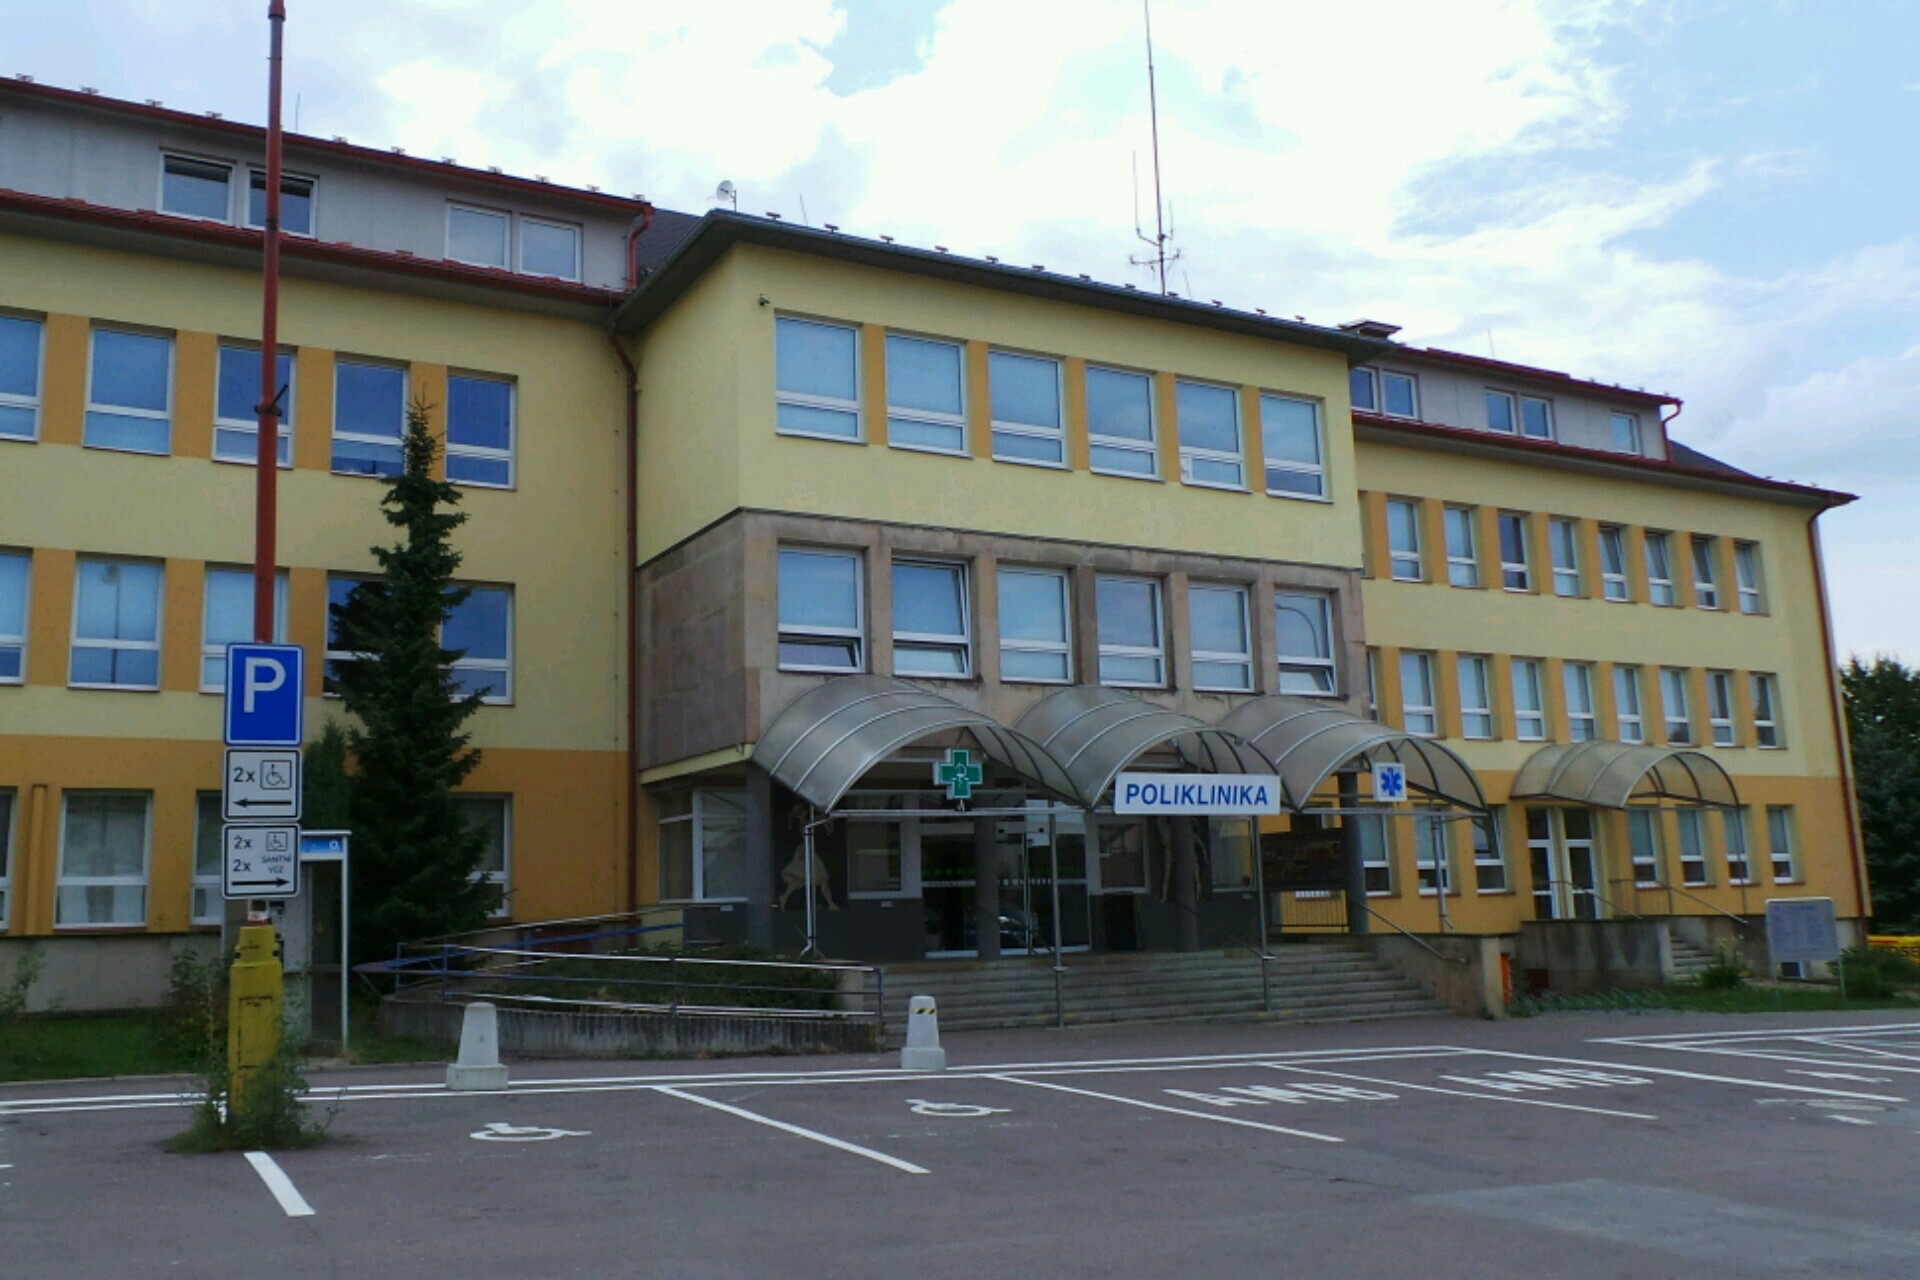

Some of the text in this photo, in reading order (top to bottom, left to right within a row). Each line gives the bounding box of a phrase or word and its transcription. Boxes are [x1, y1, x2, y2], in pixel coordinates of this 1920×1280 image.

[243, 656, 286, 713] P
[233, 767, 255, 782] 2x
[1125, 783, 1268, 806] POLIKLINIKA
[233, 836, 253, 849] 2x
[232, 859, 251, 872] 2x
